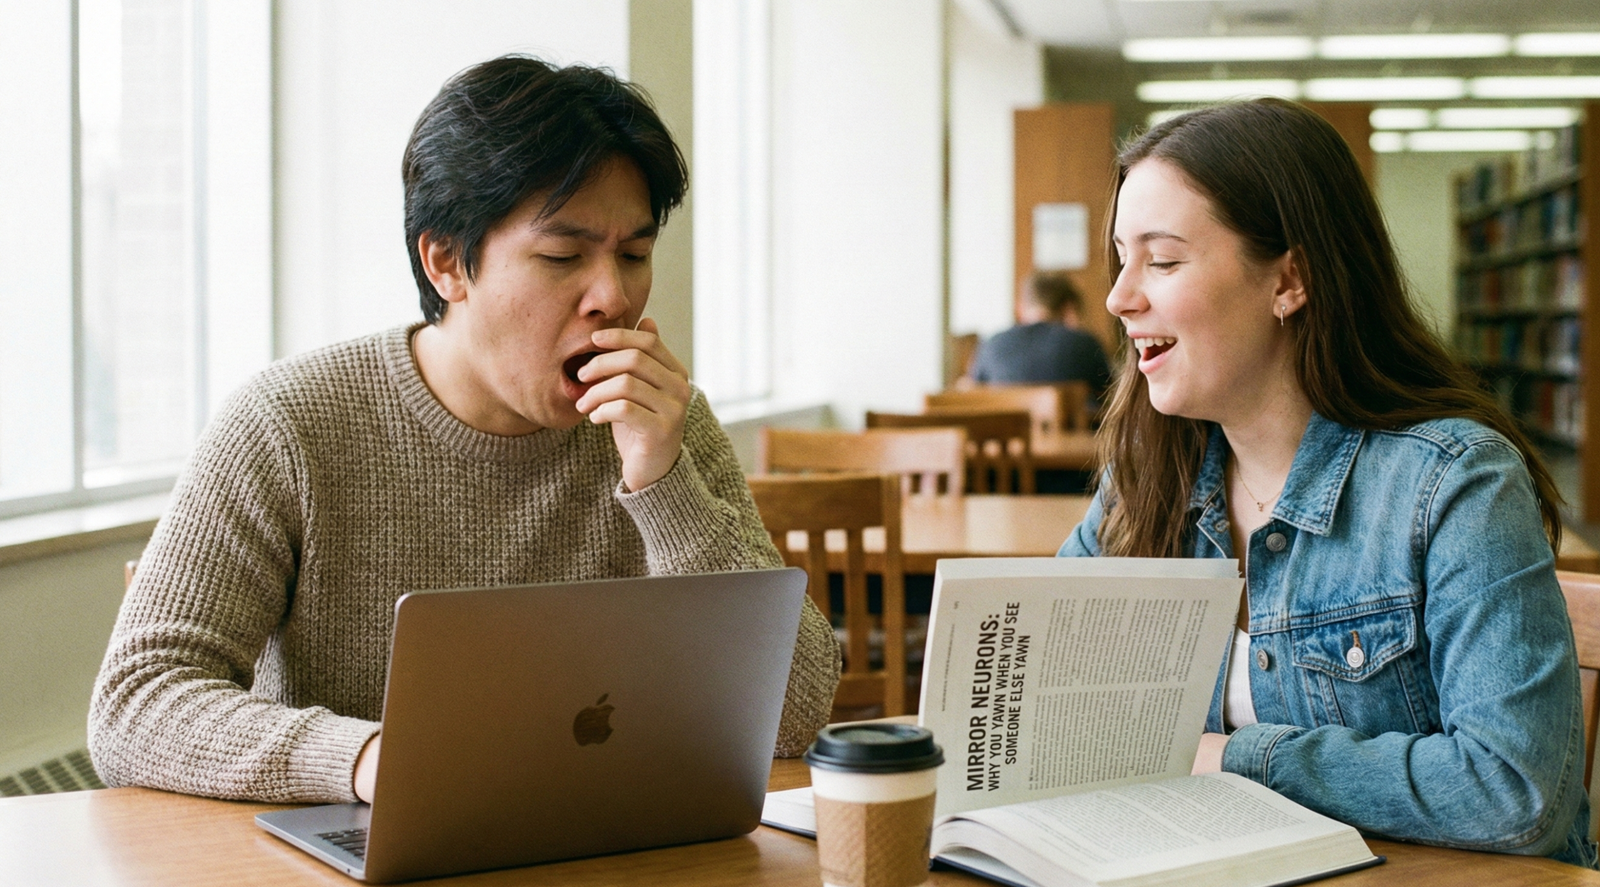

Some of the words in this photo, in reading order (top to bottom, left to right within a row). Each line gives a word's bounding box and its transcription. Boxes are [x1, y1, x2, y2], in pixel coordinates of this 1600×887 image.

[1004, 602, 1020, 624] SEE
[1000, 627, 1016, 651] YOU
[1013, 635, 1031, 670] YAWN
[971, 614, 1000, 709] NEURONS:
[995, 654, 1012, 690] WHEN
[1010, 673, 1025, 702] ELSE
[991, 694, 1006, 730] YAWN
[966, 715, 988, 791] MIRROR
[989, 734, 1003, 759] YOU
[1005, 706, 1021, 765] SOMEONE
[988, 763, 1001, 792] WHY
